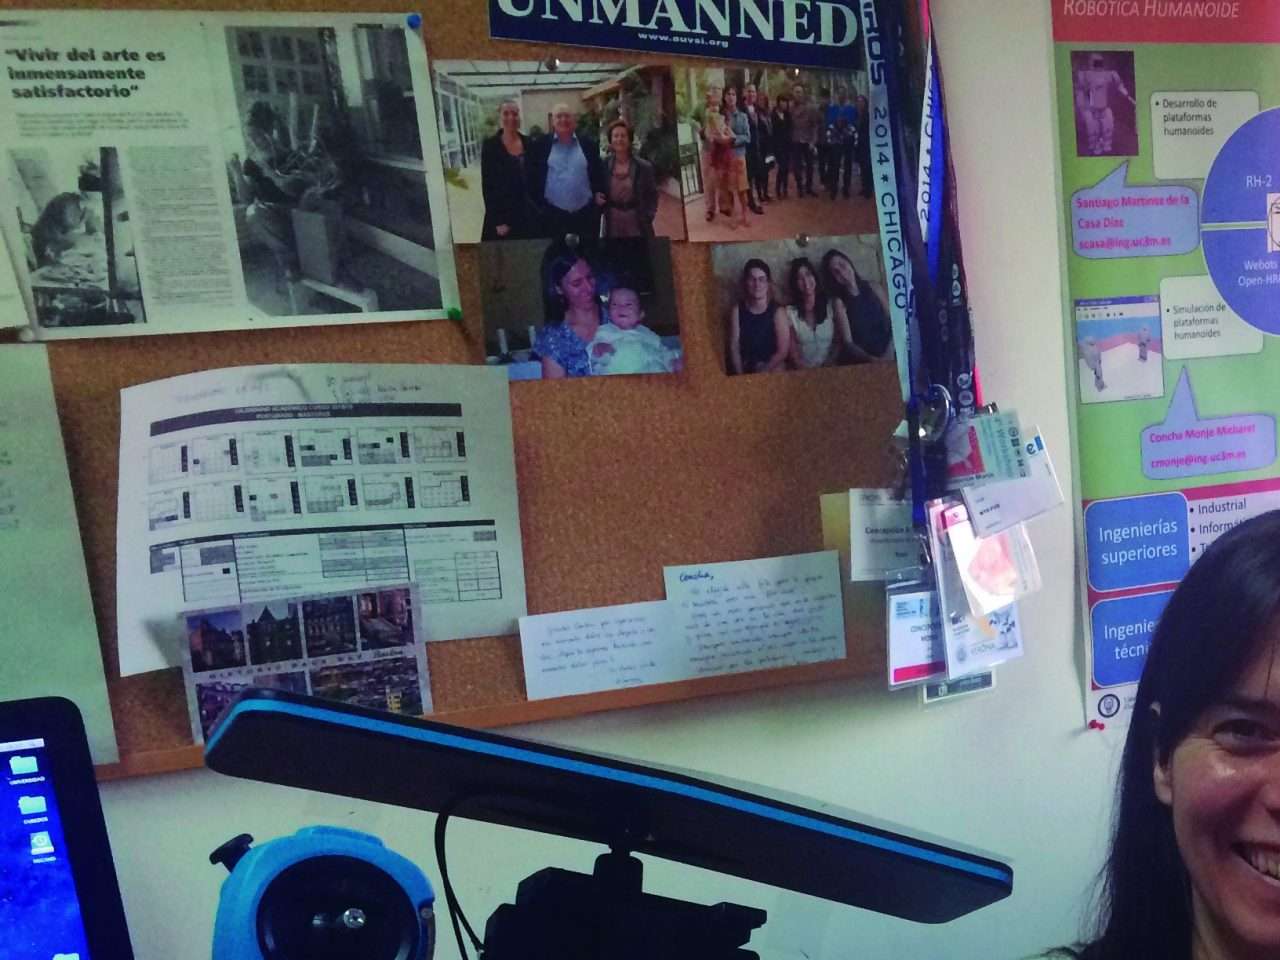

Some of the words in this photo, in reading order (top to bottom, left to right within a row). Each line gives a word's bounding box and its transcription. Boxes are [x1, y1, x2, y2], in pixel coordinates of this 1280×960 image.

[1144, 0, 1240, 18] HUMANOIDE
[66, 48, 96, 61] del
[102, 48, 140, 61] arte
[145, 50, 166, 61] es
[7, 66, 146, 80] inmensamente
[1162, 98, 1205, 109] Desarrollo
[1206, 98, 1217, 108] de
[1163, 113, 1212, 122] plataformas
[873, 105, 890, 167] 2014
[1163, 126, 1214, 136] humanoides
[1245, 174, 1273, 188] RH-2
[1076, 197, 1119, 209] Santiago
[1166, 194, 1178, 205] de
[1179, 194, 1190, 205] la
[1078, 218, 1100, 229] Casa
[880, 190, 906, 310] CHICAGO
[1243, 259, 1278, 271] Webots
[1216, 302, 1226, 312] de
[1174, 318, 1219, 329] plataformas
[1174, 330, 1221, 341] humanoides
[1150, 432, 1183, 443] Concha
[1198, 497, 1248, 515] Industrial
[1099, 518, 1178, 545] Ingenierías
[1101, 543, 1178, 566] superiores
[1104, 619, 1154, 642] Ingenie
[1115, 643, 1149, 661] técni
